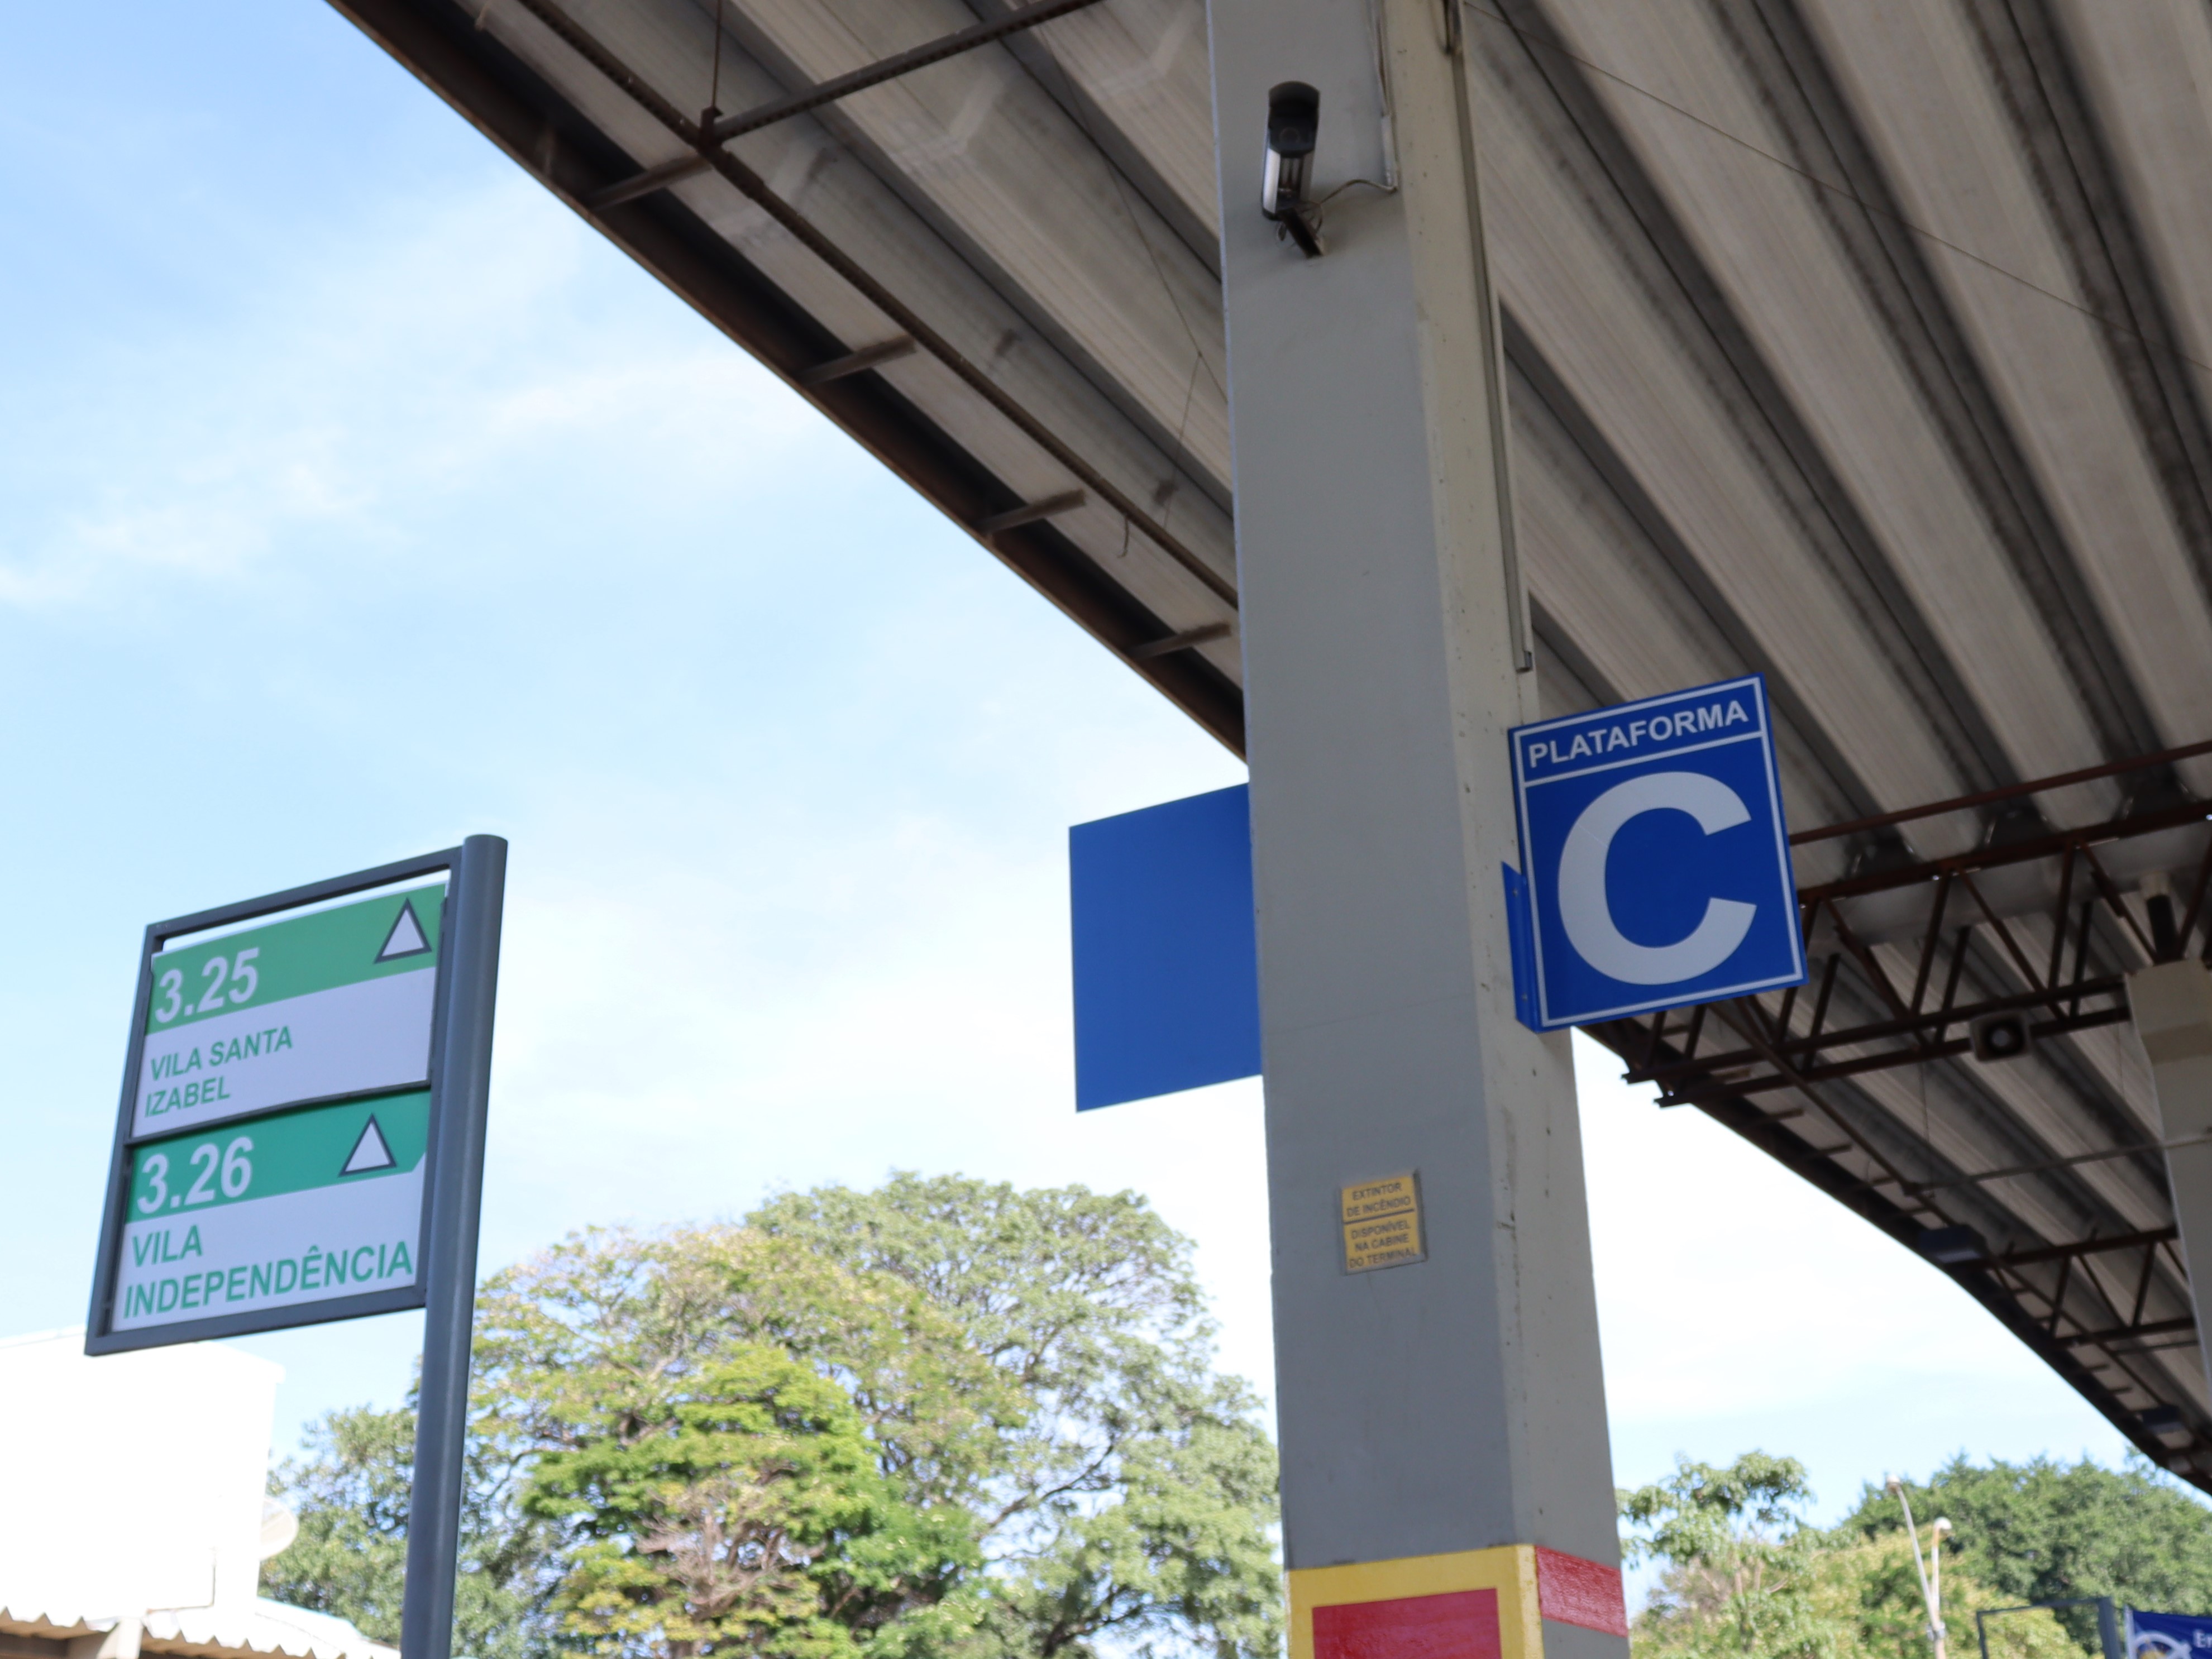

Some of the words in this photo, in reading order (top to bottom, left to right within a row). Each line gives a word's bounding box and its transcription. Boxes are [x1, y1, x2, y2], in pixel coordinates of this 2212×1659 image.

[1527, 700, 1748, 768] PLATAFORMA
[1558, 771, 1757, 986] C
[155, 947, 259, 1024] 3.25
[150, 1047, 202, 1081] VILA
[210, 1025, 293, 1067] SANTA
[145, 1077, 231, 1116] IZABEL
[136, 1135, 255, 1215] 3.26
[1353, 1183, 1402, 1201] EXTINTOR
[1346, 1207, 1360, 1217] DE
[131, 1224, 203, 1267] VILA
[1349, 1258, 1364, 1268] DO
[1367, 1247, 1416, 1264] TERMINAL
[1355, 1242, 1368, 1251] NA
[1372, 1234, 1409, 1249] CABINE
[124, 1241, 413, 1318] INDEPENDÊNCIA
